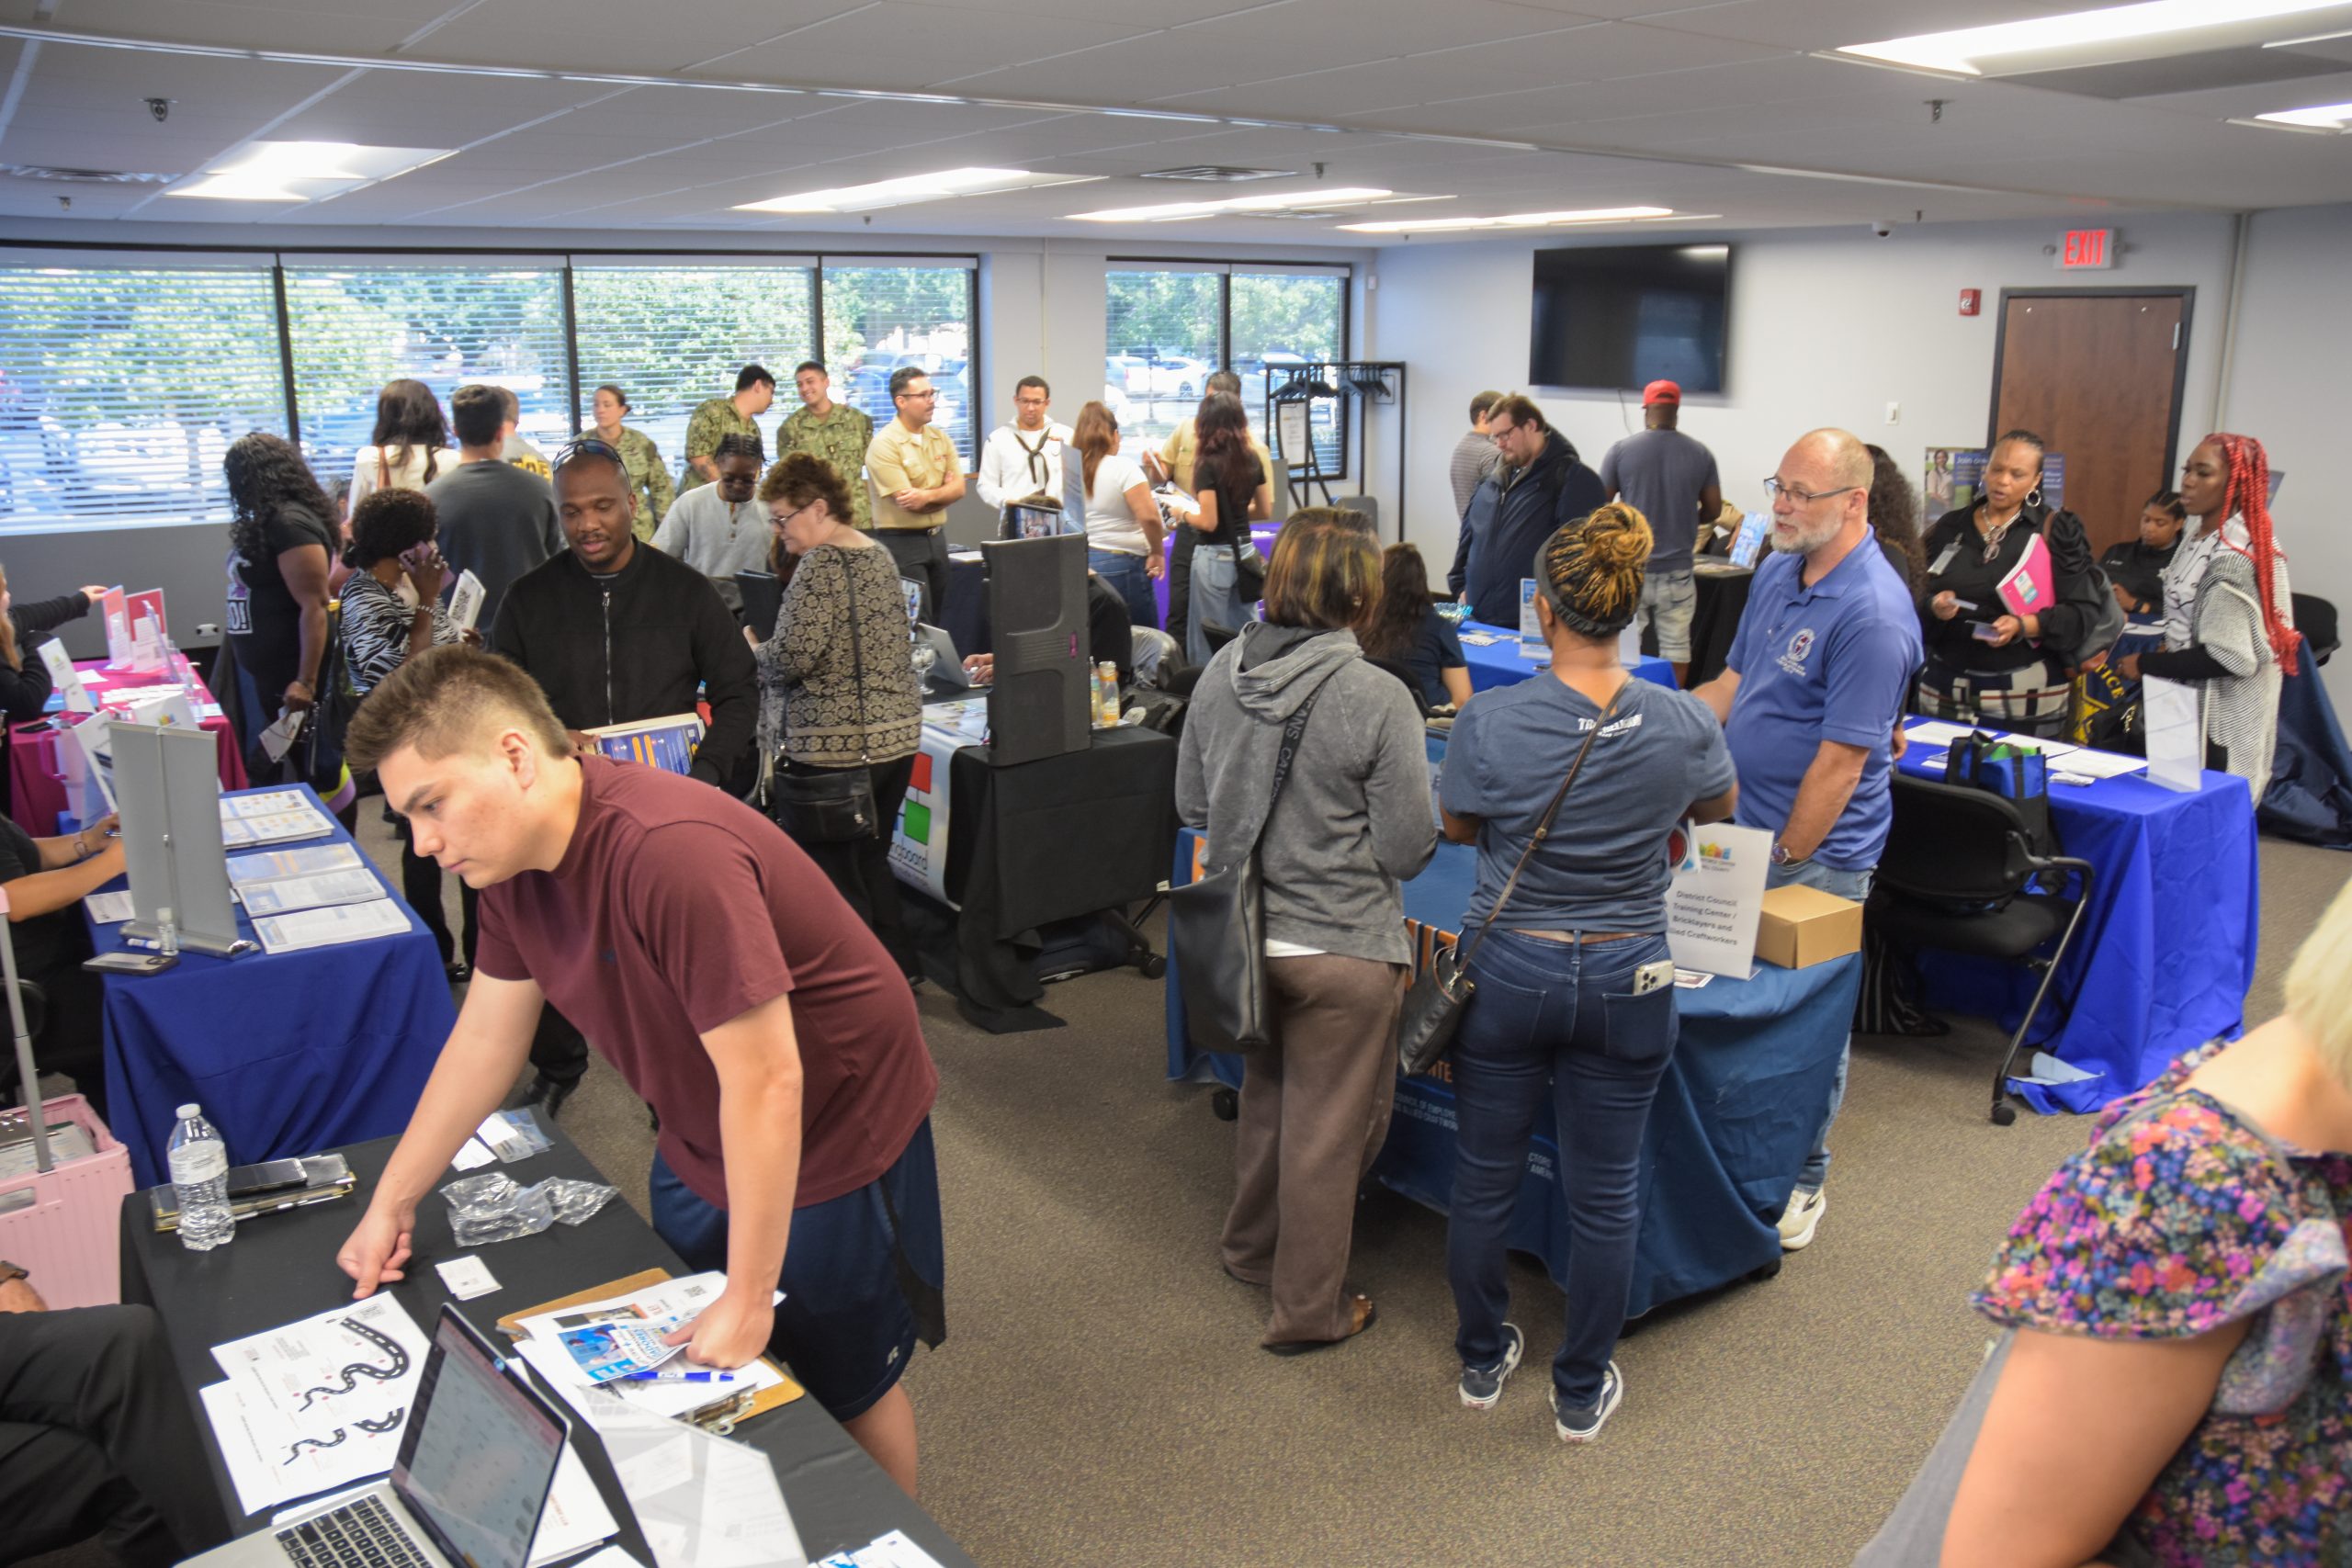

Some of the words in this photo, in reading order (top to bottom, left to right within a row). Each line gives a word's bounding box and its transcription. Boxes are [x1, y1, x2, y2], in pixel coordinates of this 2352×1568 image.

[2064, 230, 2107, 265] EXIT
[1677, 890, 1705, 901] District
[1706, 896, 1738, 907] Council
[1673, 903, 1704, 915] Training
[1704, 908, 1732, 919] Center
[1672, 915, 1716, 929] Bricklayers
[1717, 923, 1734, 931] and
[1687, 931, 1738, 945] Craftworkers
